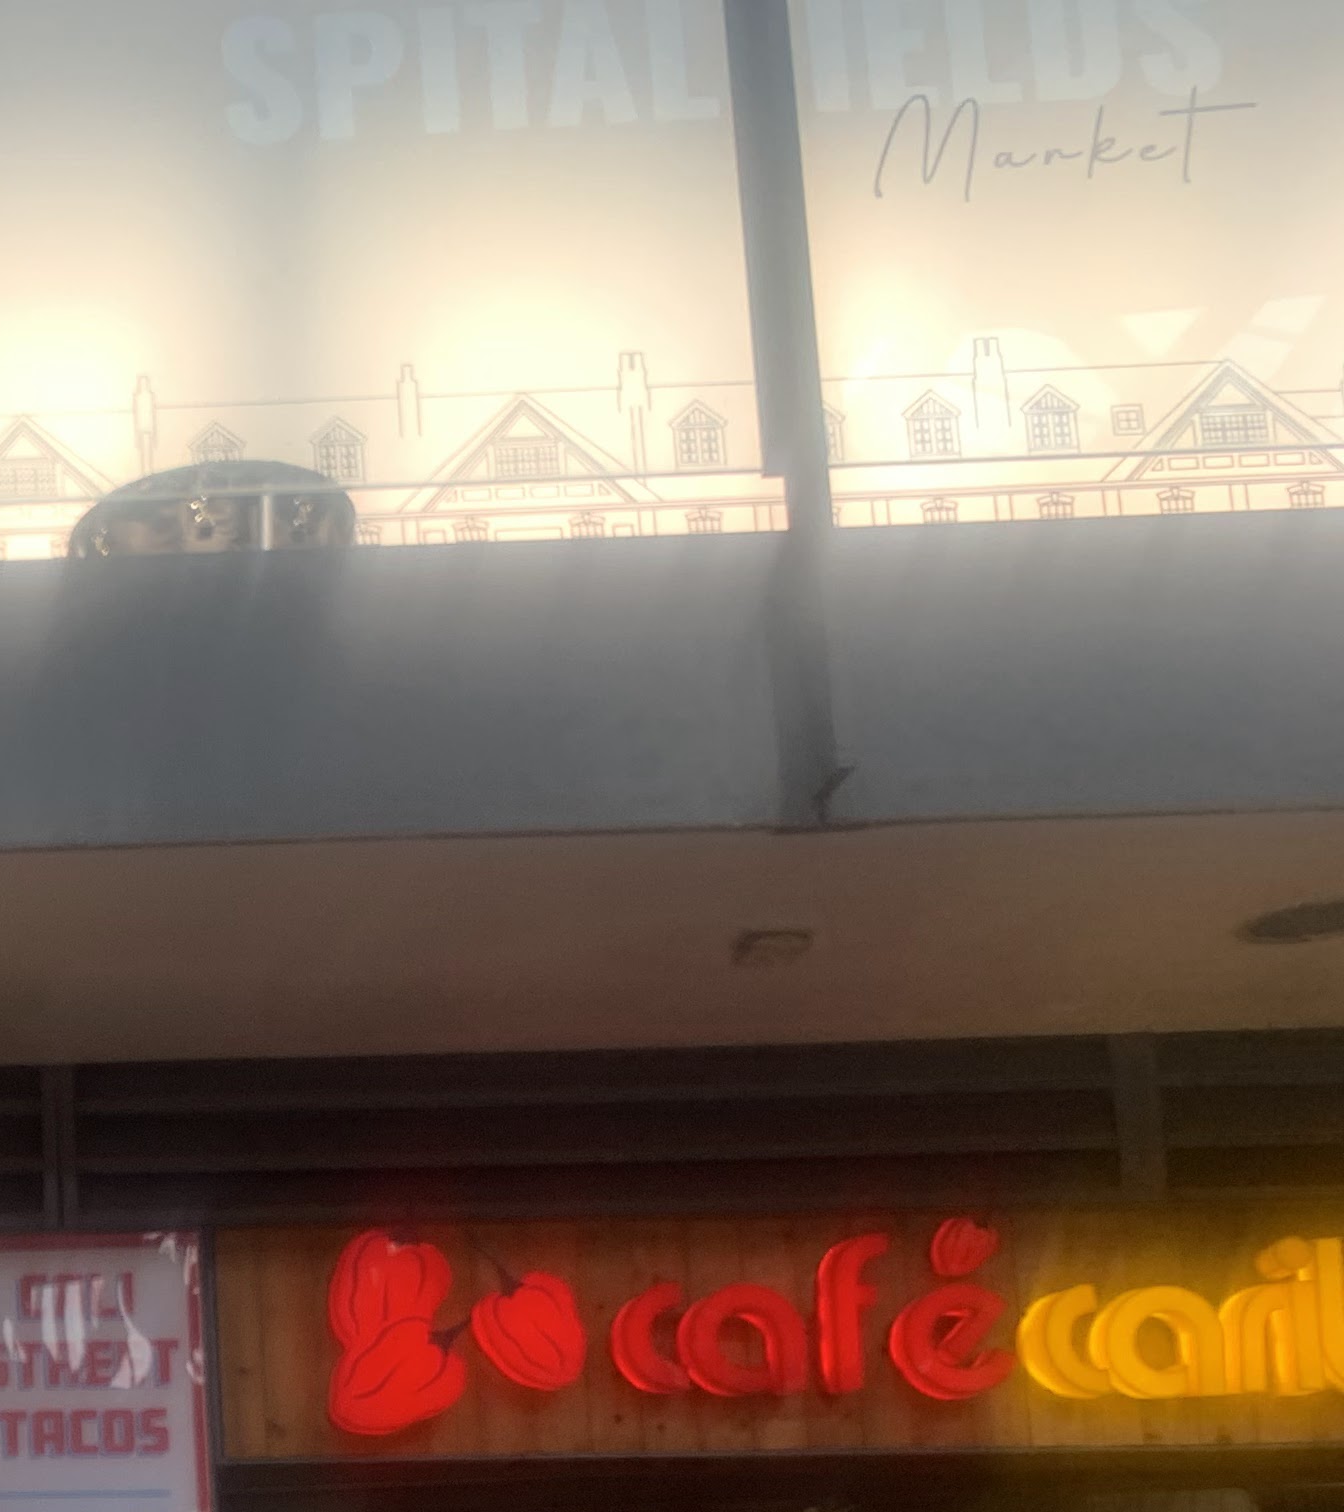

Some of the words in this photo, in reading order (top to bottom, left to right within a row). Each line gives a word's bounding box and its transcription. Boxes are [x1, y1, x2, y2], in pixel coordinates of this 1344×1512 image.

[221, 0, 1223, 146] SPITALIELDS
[874, 85, 1257, 202] Market
[610, 1216, 1016, 1399] café
